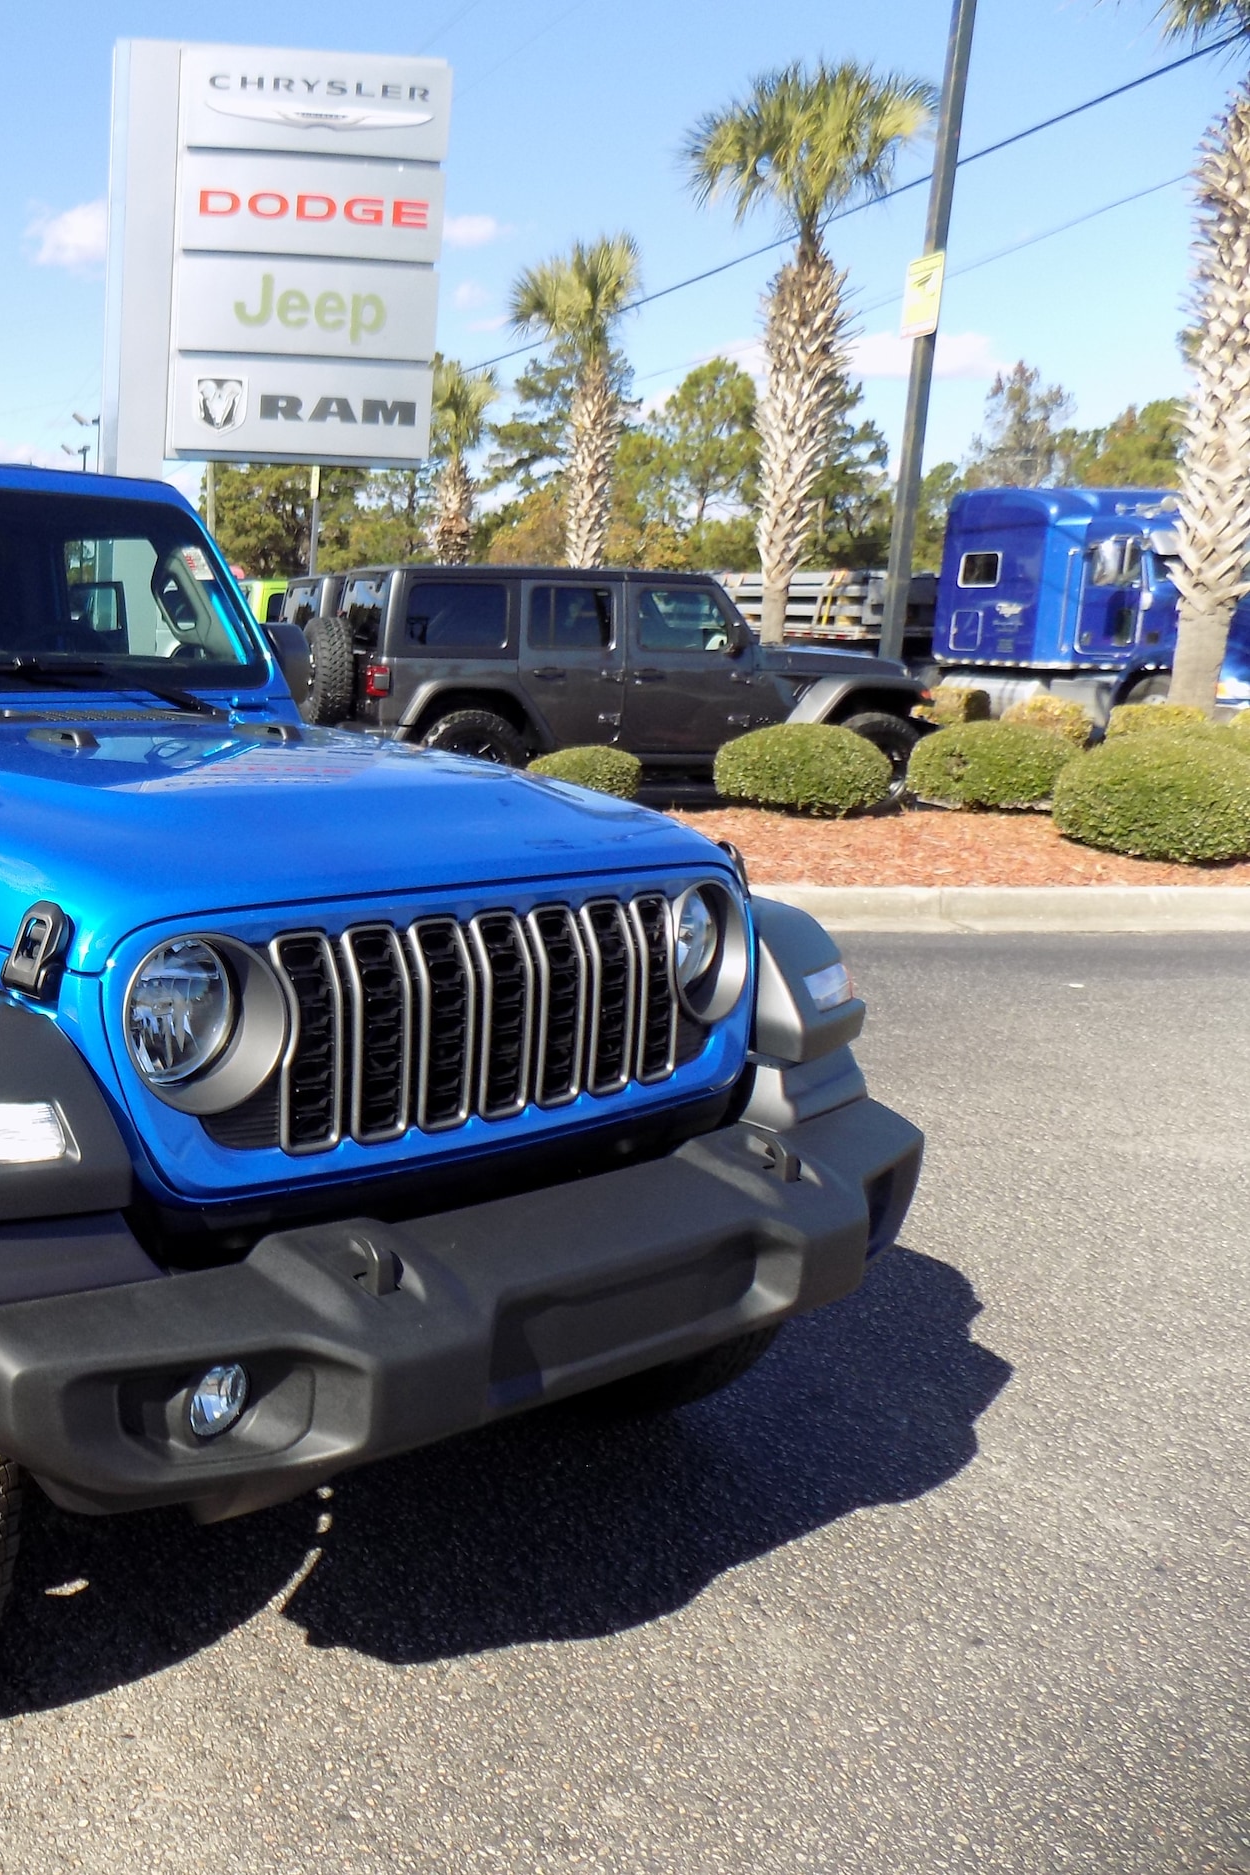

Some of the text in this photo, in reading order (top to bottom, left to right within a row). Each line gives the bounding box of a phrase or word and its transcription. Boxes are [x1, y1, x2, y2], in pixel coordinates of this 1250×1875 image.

[209, 73, 430, 102] CHRYSLER
[199, 190, 429, 229] DODGE
[234, 274, 386, 343] Jeep
[259, 394, 416, 426] RAM
